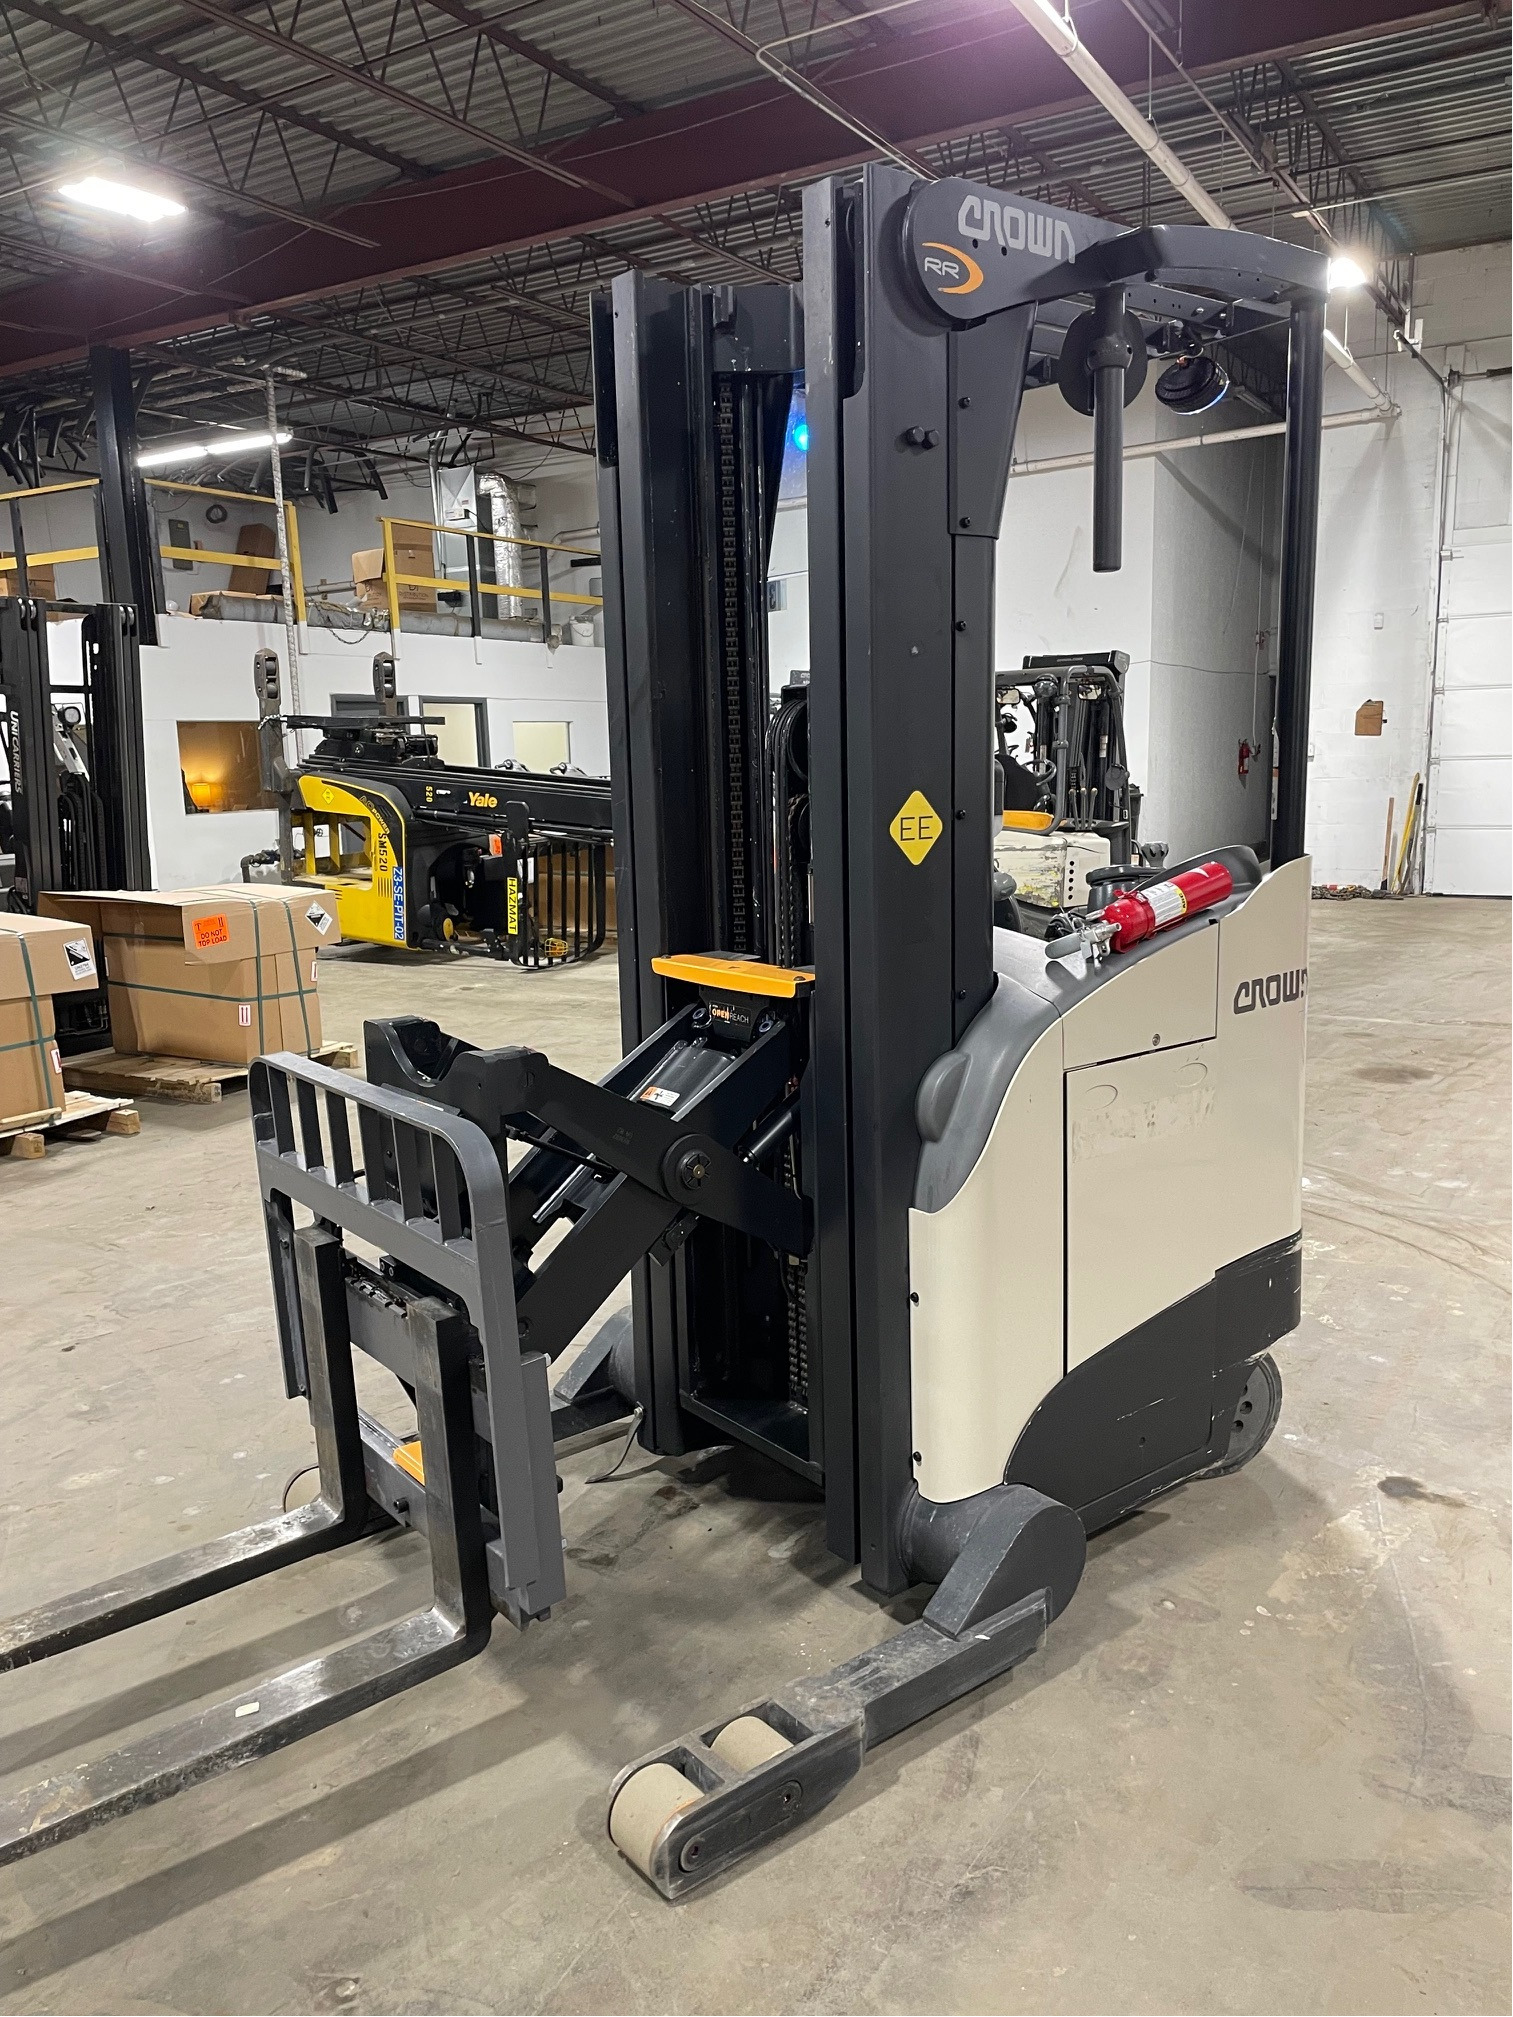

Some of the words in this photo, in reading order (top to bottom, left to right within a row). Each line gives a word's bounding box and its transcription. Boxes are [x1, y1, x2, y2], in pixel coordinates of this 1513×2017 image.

[958, 195, 1075, 264] CROWN
[924, 257, 959, 279] RR
[10, 710, 23, 795] UNICARRIERS
[425, 785, 433, 803] 520
[468, 791, 498, 808] Yale
[371, 808, 390, 835] POWER
[900, 815, 933, 841] EE
[377, 832, 388, 872] SM520
[508, 878, 517, 933] HAZMAT
[198, 938, 211, 947] TOP
[211, 935, 228, 944] LOAD
[200, 931, 210, 940] DO
[210, 928, 223, 937] NOT
